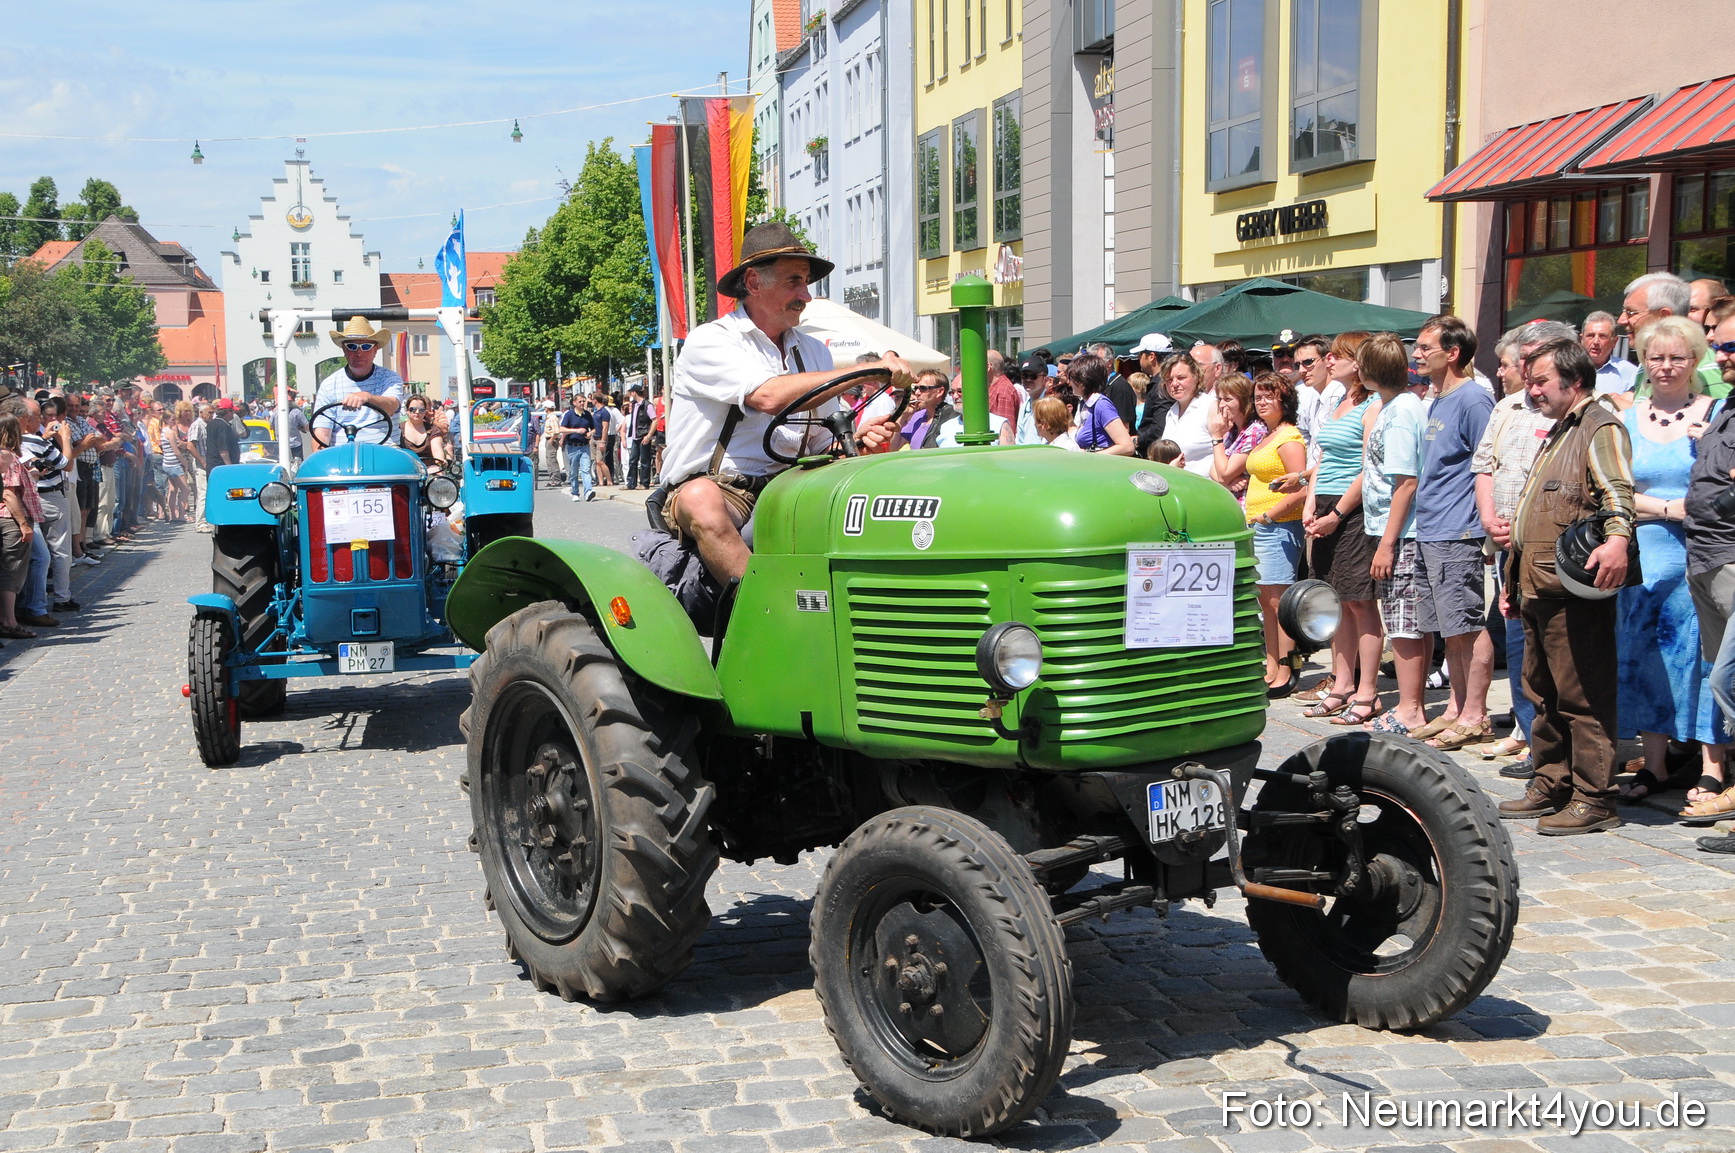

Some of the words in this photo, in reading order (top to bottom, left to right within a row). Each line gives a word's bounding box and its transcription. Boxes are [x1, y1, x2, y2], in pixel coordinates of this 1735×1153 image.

[1236, 209, 1280, 242] GERRY
[1278, 199, 1327, 236] WEBER
[352, 498, 384, 515] 155
[875, 499, 934, 517] DIESEL
[1170, 562, 1221, 592] 229
[350, 645, 368, 657] NM
[348, 658, 365, 670] PM
[370, 657, 386, 669] 27
[1165, 782, 1191, 809] NM
[1154, 801, 1160, 809] D
[1156, 809, 1181, 838] HK
[1190, 801, 1225, 831] 128
